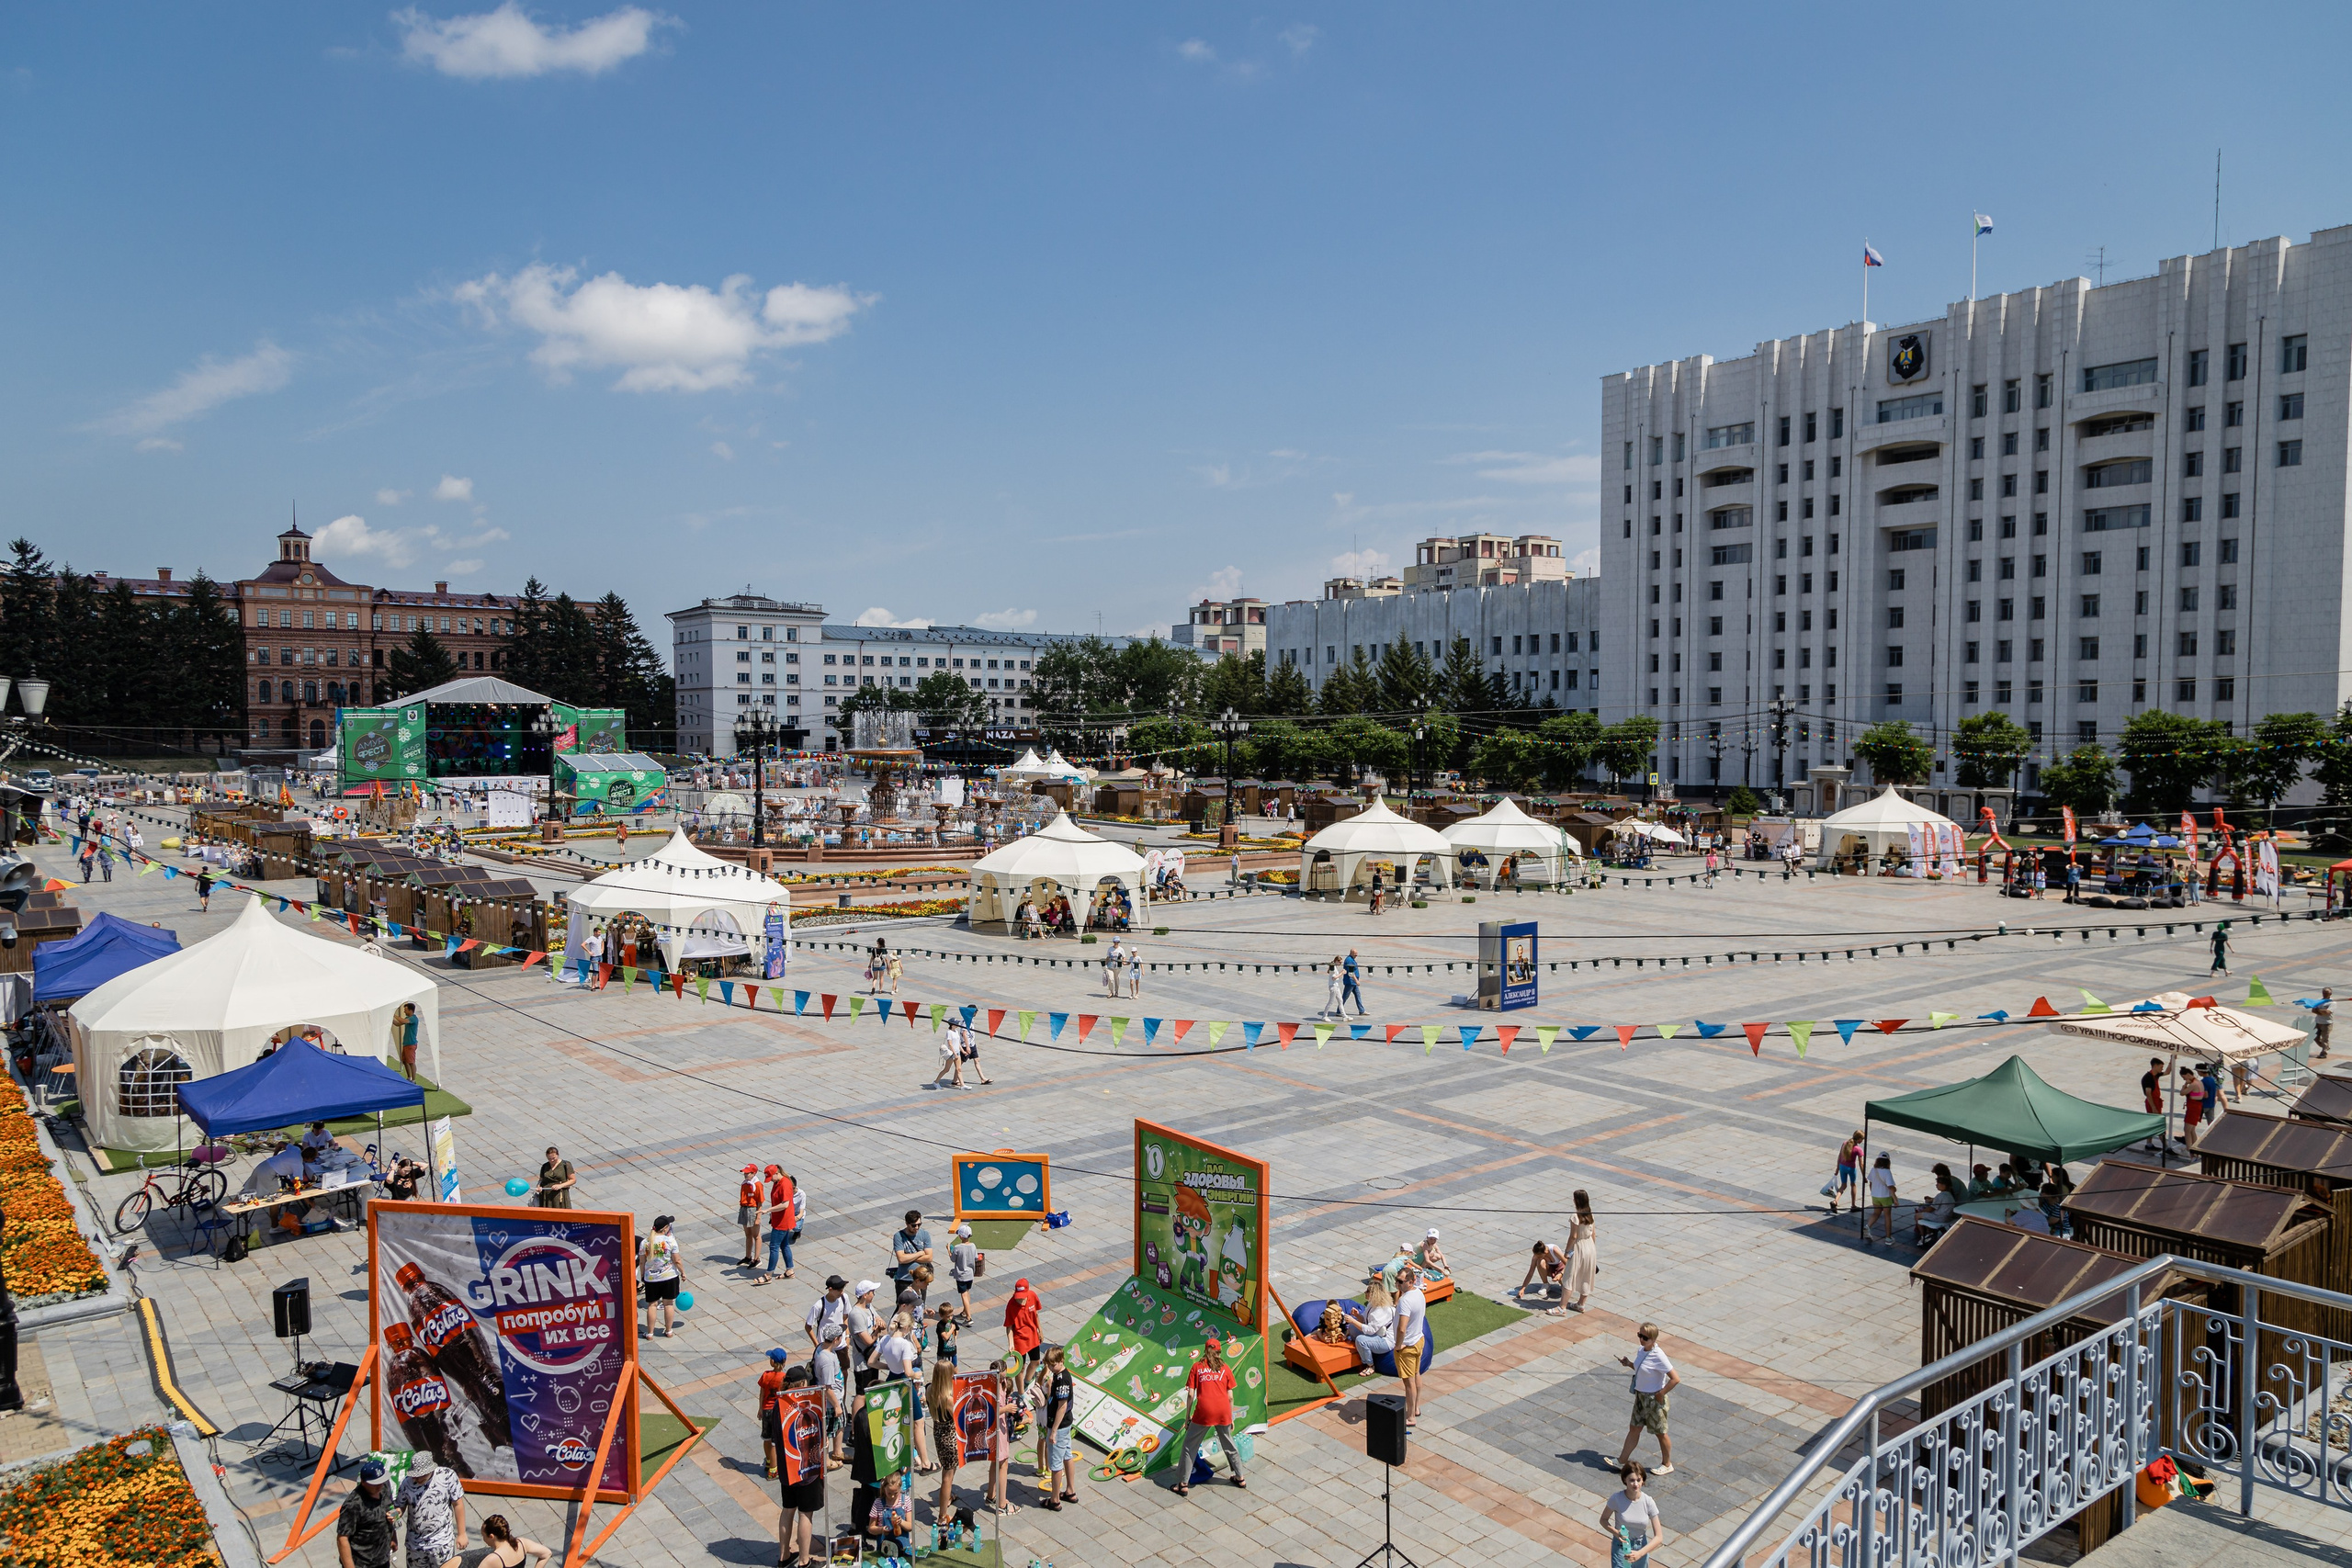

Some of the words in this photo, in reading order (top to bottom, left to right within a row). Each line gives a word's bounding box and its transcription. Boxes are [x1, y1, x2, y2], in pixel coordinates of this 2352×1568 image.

[986, 731, 1016, 739] NAZA
[357, 738, 385, 751] АМУР
[404, 744, 421, 753] АМУР
[357, 745, 386, 758] ФЕСТ
[403, 749, 422, 759] ФЕСТ
[2079, 1027, 2106, 1038] УРА!!!
[1206, 1164, 1224, 1173] ДЛЯ
[1183, 1171, 1246, 1189] ЗДОРОВЬЯ
[1207, 1189, 1255, 1204] ЭНЕРГИИ
[461, 1255, 609, 1310] GRINK
[503, 1300, 601, 1330] попробуй
[422, 1305, 469, 1345] Cola
[545, 1328, 571, 1345] их
[574, 1325, 611, 1341] все
[1197, 1367, 1221, 1375] SLAV
[1199, 1374, 1219, 1382] GROUP
[395, 1383, 447, 1413] Cola
[547, 1444, 595, 1461] Cola
